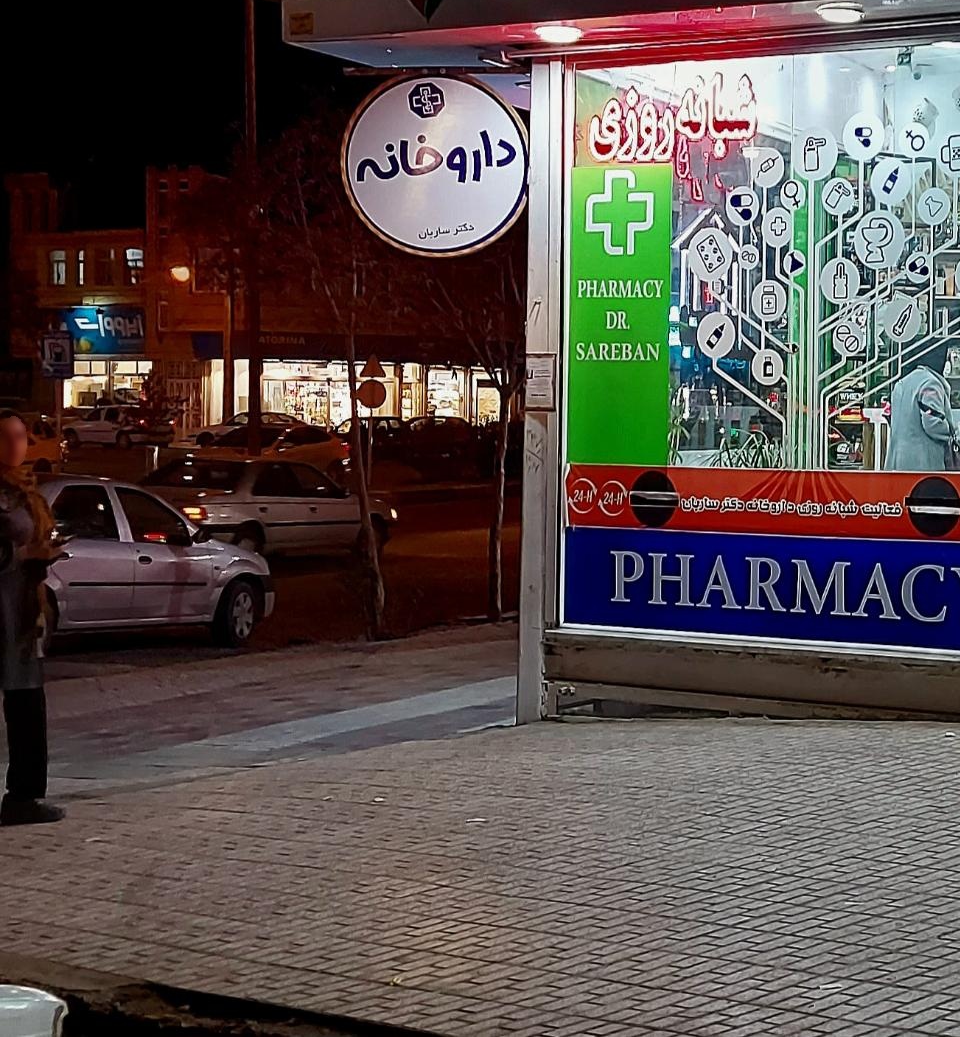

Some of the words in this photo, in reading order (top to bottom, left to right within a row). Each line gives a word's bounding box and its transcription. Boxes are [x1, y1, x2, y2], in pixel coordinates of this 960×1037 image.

[356, 130, 517, 183] داروخانه
[418, 226, 451, 240] ساربان
[453, 222, 475, 236] دکتر
[577, 279, 664, 298] PHARMACY
[606, 310, 630, 330] DR.
[576, 342, 660, 361] SAREBAN
[573, 489, 593, 503] 24-H
[603, 491, 623, 505] 24-H
[681, 496, 720, 514] ساربان
[720, 496, 745, 513] دکتر
[824, 499, 859, 519] شبانه
